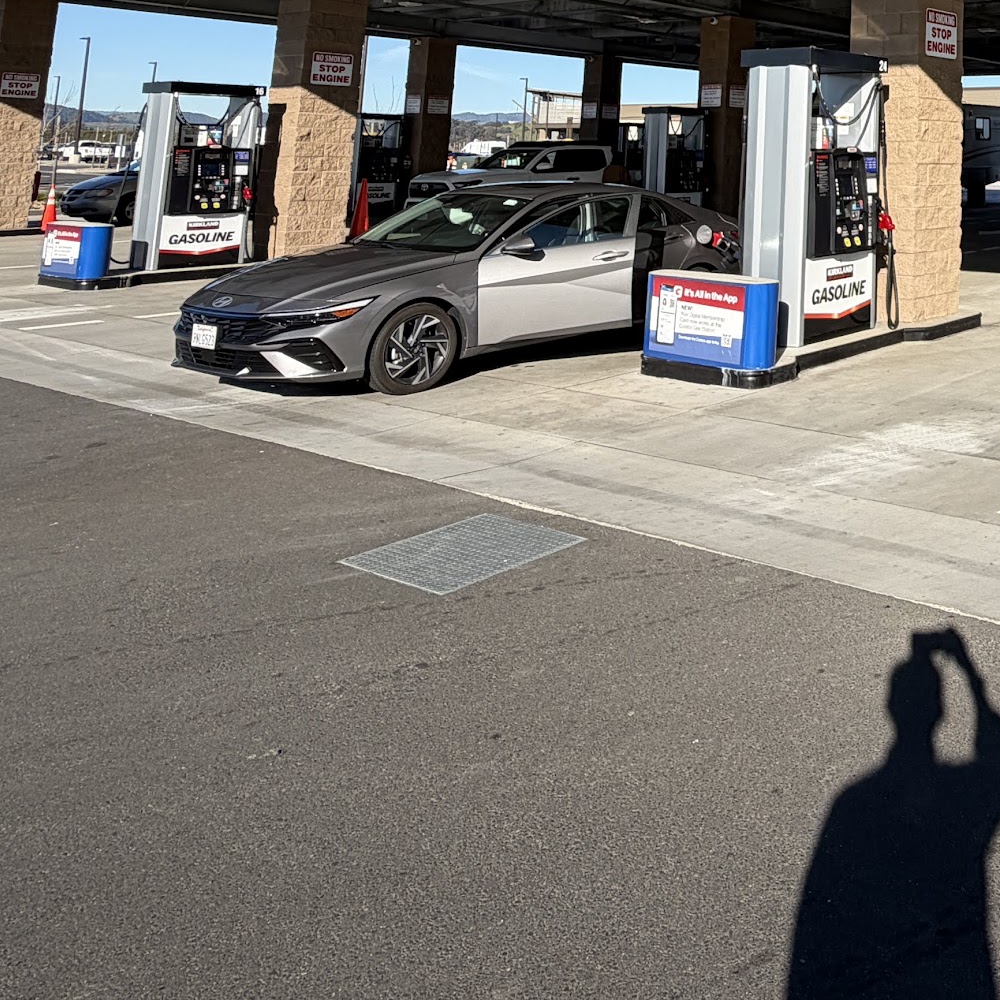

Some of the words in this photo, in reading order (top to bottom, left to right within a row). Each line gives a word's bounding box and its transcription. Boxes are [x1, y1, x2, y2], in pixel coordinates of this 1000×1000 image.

[928, 11, 936, 22] NO
[936, 13, 955, 26] SMOKING
[931, 26, 952, 40] STOP
[927, 40, 956, 55] ENGINE
[315, 54, 324, 62] NO
[325, 55, 351, 64] SMOKING
[879, 59, 888, 72] 24
[319, 64, 346, 74] STOP
[312, 73, 351, 84] ENGINE
[1, 89, 37, 97] ENGINE
[255, 87, 265, 96] 16
[168, 231, 235, 245] GASOLINE
[684, 287, 694, 297] It's
[694, 289, 704, 299] All
[704, 290, 710, 299] in
[711, 291, 723, 301] the
[723, 292, 738, 304] App
[812, 280, 866, 305] GASOLINE
